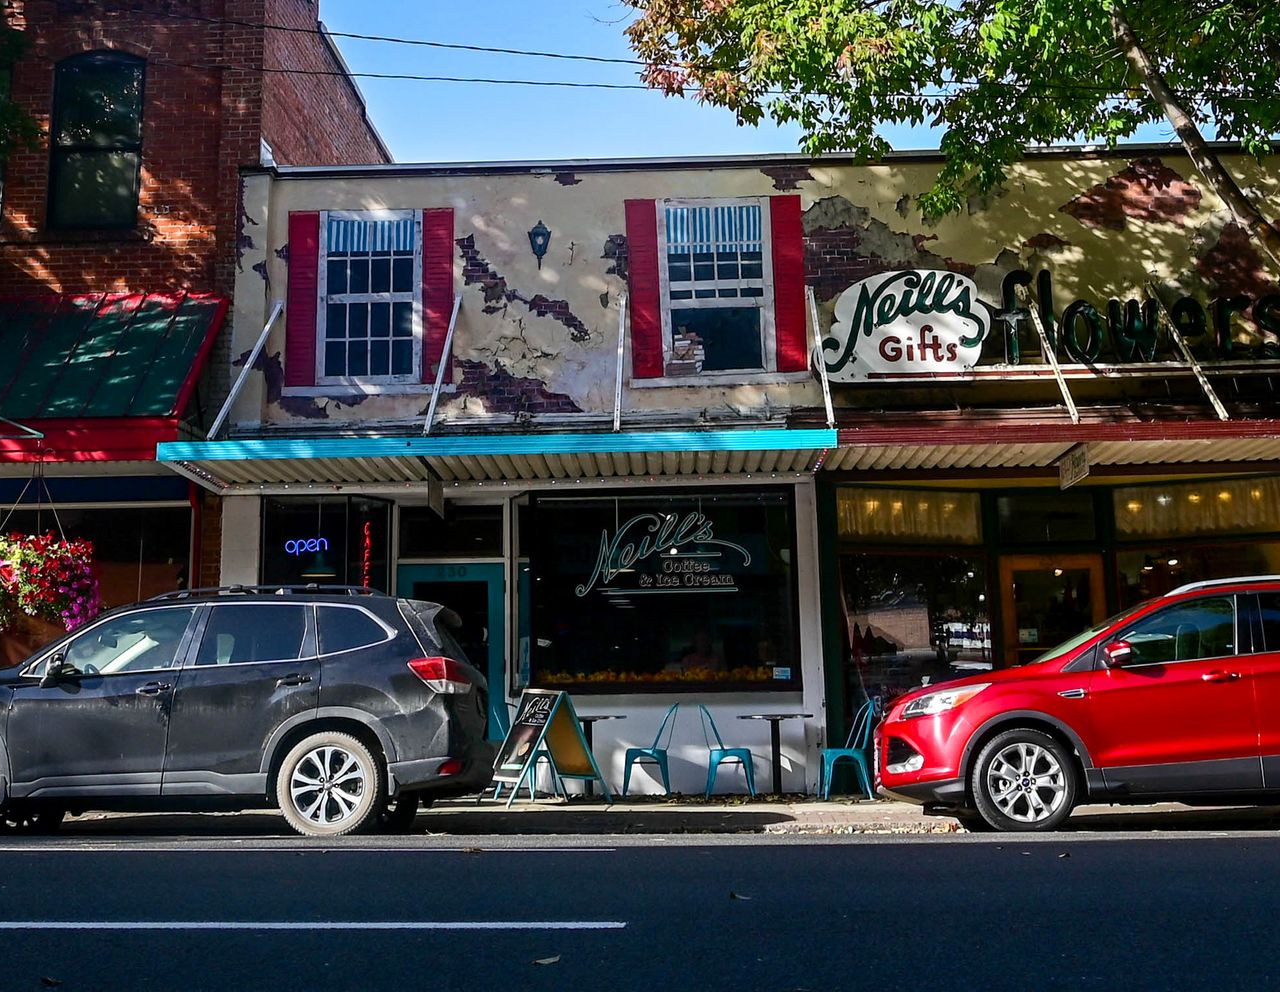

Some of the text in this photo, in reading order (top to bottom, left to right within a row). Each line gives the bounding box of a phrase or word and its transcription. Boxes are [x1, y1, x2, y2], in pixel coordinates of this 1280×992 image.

[821, 269, 985, 374] Neill's
[878, 324, 958, 363] Gifts
[284, 537, 329, 556] open
[575, 510, 752, 597] Neill's
[638, 572, 735, 587] & Ice Cream
[663, 559, 711, 574] Coffee
